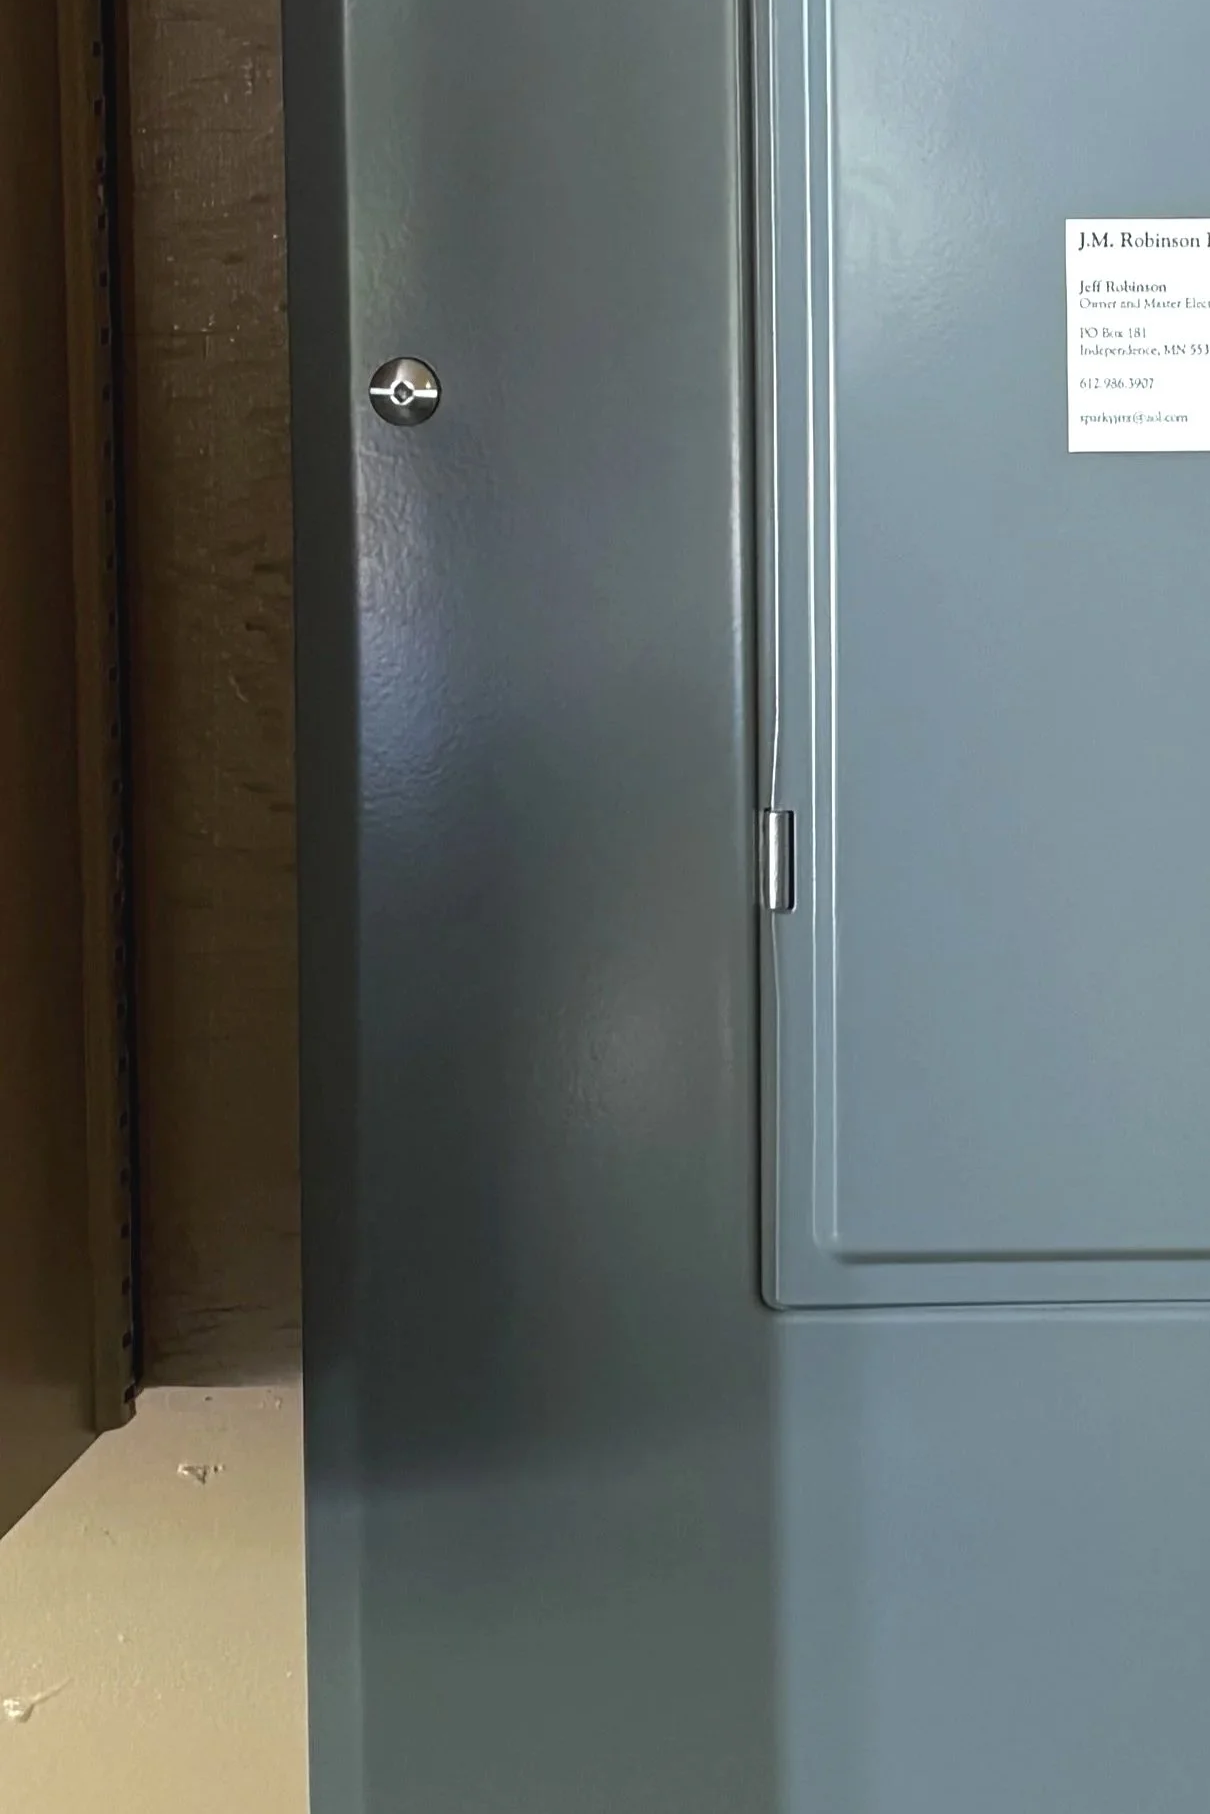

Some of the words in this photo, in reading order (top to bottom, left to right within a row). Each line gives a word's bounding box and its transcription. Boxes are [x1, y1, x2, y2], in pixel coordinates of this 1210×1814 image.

[1078, 231, 1115, 251] J.M.
[1120, 231, 1200, 249] Robinson
[1078, 279, 1102, 295] Jeff
[1106, 280, 1167, 293] Robinson
[1079, 298, 1117, 309] Owner
[1120, 297, 1141, 309] and
[1144, 297, 1182, 309] Master
[1080, 327, 1098, 338] PO
[1102, 327, 1124, 338] Box
[1128, 327, 1147, 338] 181
[1080, 344, 1161, 358] Independence,
[1163, 344, 1187, 356] MN
